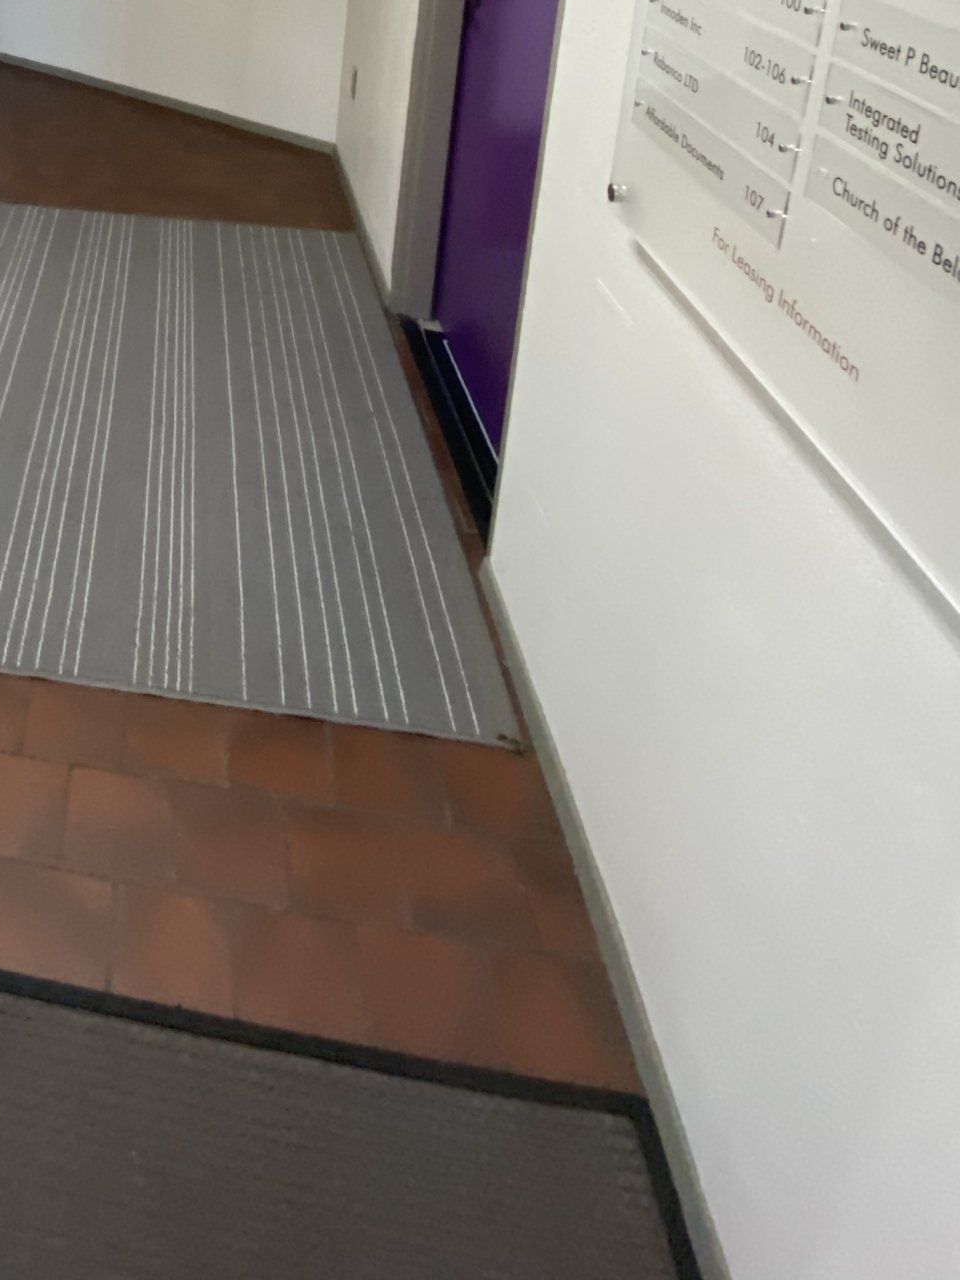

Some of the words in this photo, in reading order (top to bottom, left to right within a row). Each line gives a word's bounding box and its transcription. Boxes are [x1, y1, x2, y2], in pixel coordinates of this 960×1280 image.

[683, 73, 699, 94] LTD
[743, 46, 786, 84] 102-106
[861, 27, 901, 62] Sweet
[904, 46, 916, 67] P
[919, 53, 960, 91] Beau
[756, 122, 775, 148] 104
[845, 113, 889, 160] Testing
[848, 89, 922, 145] Integrated
[645, 106, 680, 143] Affordable
[680, 133, 725, 181] Documents
[744, 185, 765, 210] 107
[832, 176, 879, 223] Church
[883, 216, 902, 236] of
[902, 225, 927, 255] the
[931, 243, 960, 283] Bel
[712, 226, 730, 254] For
[731, 244, 775, 304] Leasing
[777, 289, 860, 383] Information
